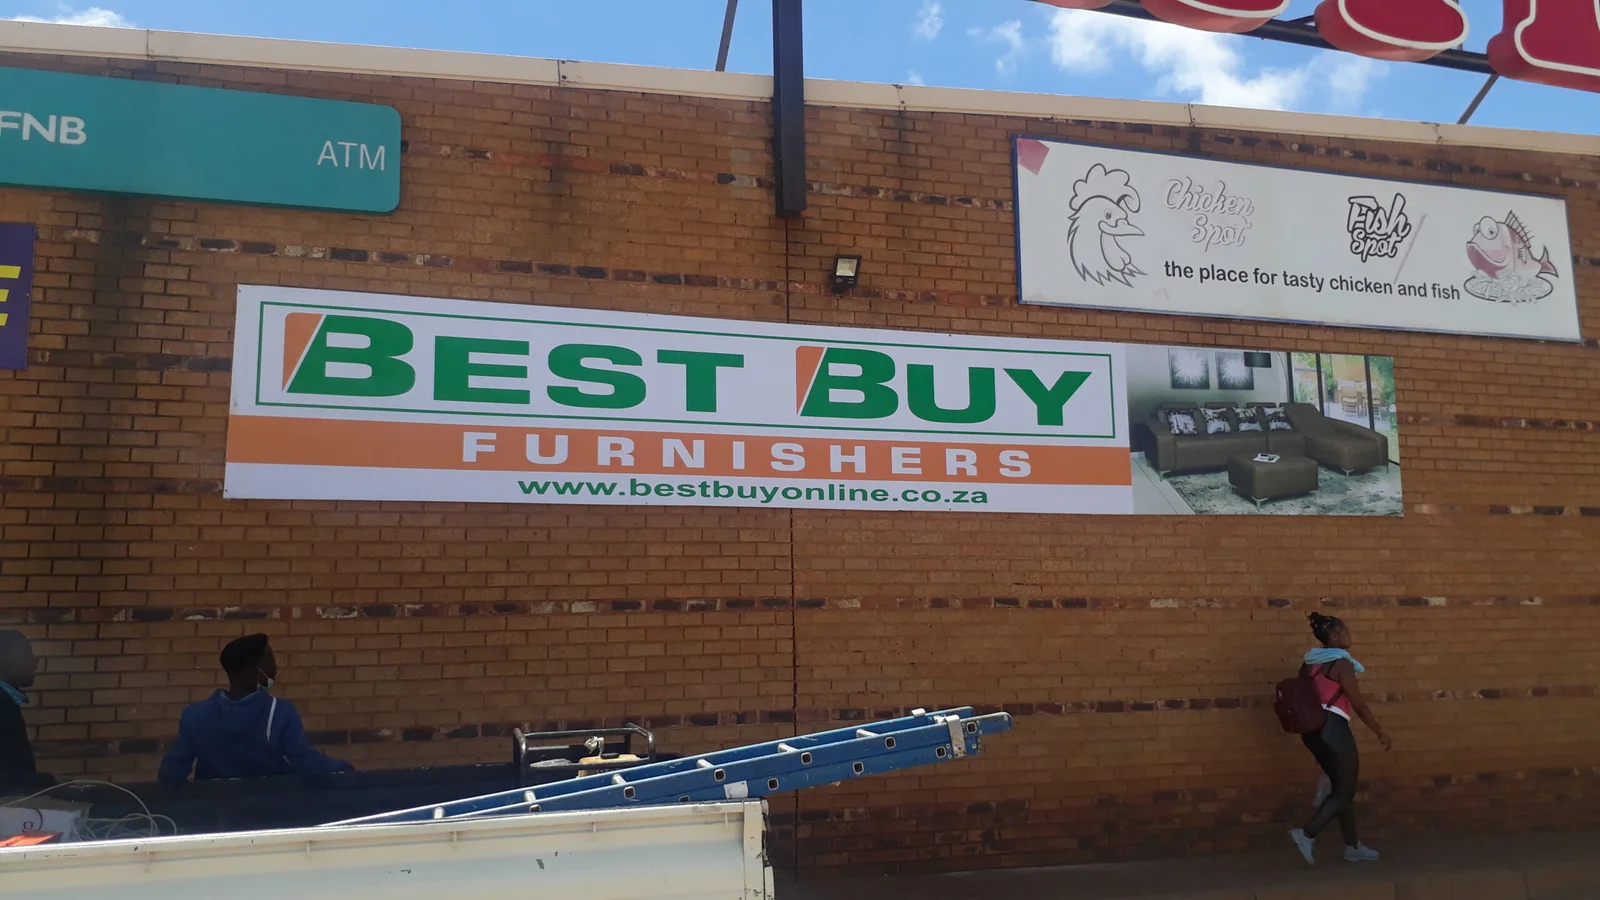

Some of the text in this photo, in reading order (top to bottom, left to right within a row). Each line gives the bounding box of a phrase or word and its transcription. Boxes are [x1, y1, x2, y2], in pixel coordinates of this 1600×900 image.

[0, 111, 87, 144] FNB
[317, 140, 386, 171] ATM
[1165, 176, 1255, 217] Chicken
[1347, 193, 1412, 238] Fish
[1191, 213, 1253, 253] Spot
[1350, 227, 1404, 263] Spot
[1164, 260, 1461, 300] the place for tasty chicken and fish
[284, 313, 1093, 427] BEST BUY
[462, 431, 1032, 478] FURNISHERS
[517, 477, 989, 504] www.bestbuyonline.co.za
